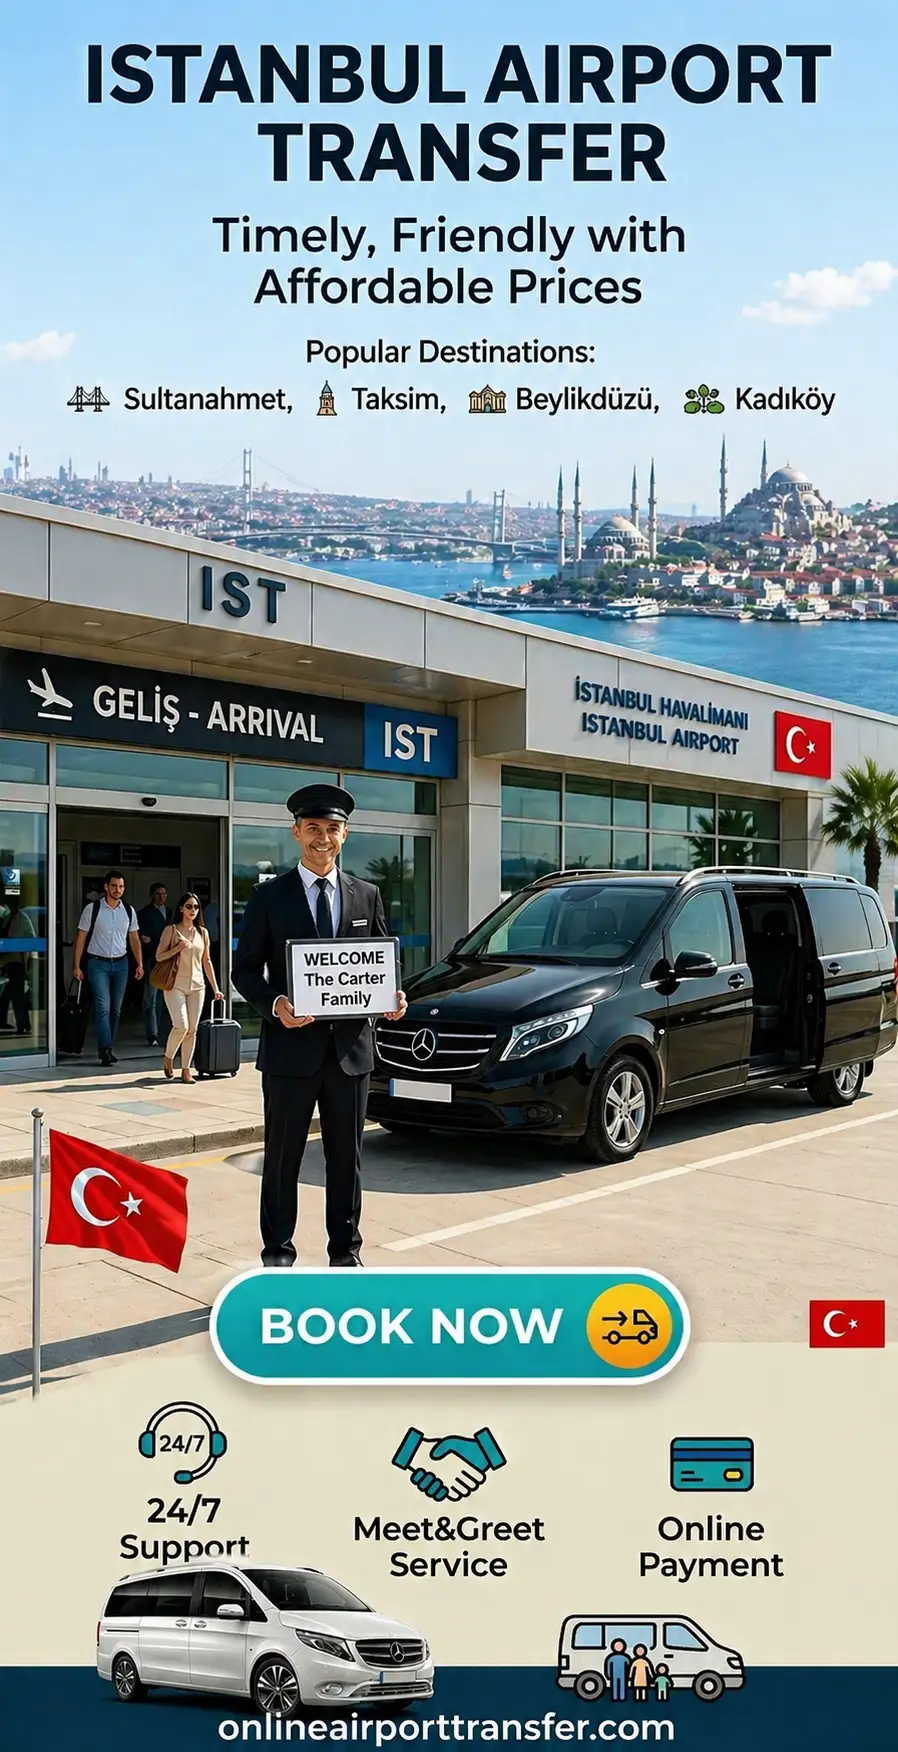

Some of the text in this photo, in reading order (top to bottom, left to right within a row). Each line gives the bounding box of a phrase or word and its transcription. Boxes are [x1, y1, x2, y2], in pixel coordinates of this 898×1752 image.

[201, 565, 287, 624] IST
[92, 685, 180, 733] GELİŞ
[206, 700, 324, 744] ARRIVAL
[574, 675, 749, 731] İSTANBUL HAVALİMANI
[383, 720, 438, 763] IST
[581, 711, 740, 755] ISTANBUL AIRPORT
[303, 950, 385, 967] WELCOME
[303, 971, 386, 987] The Carter
[320, 990, 372, 1009] Family
